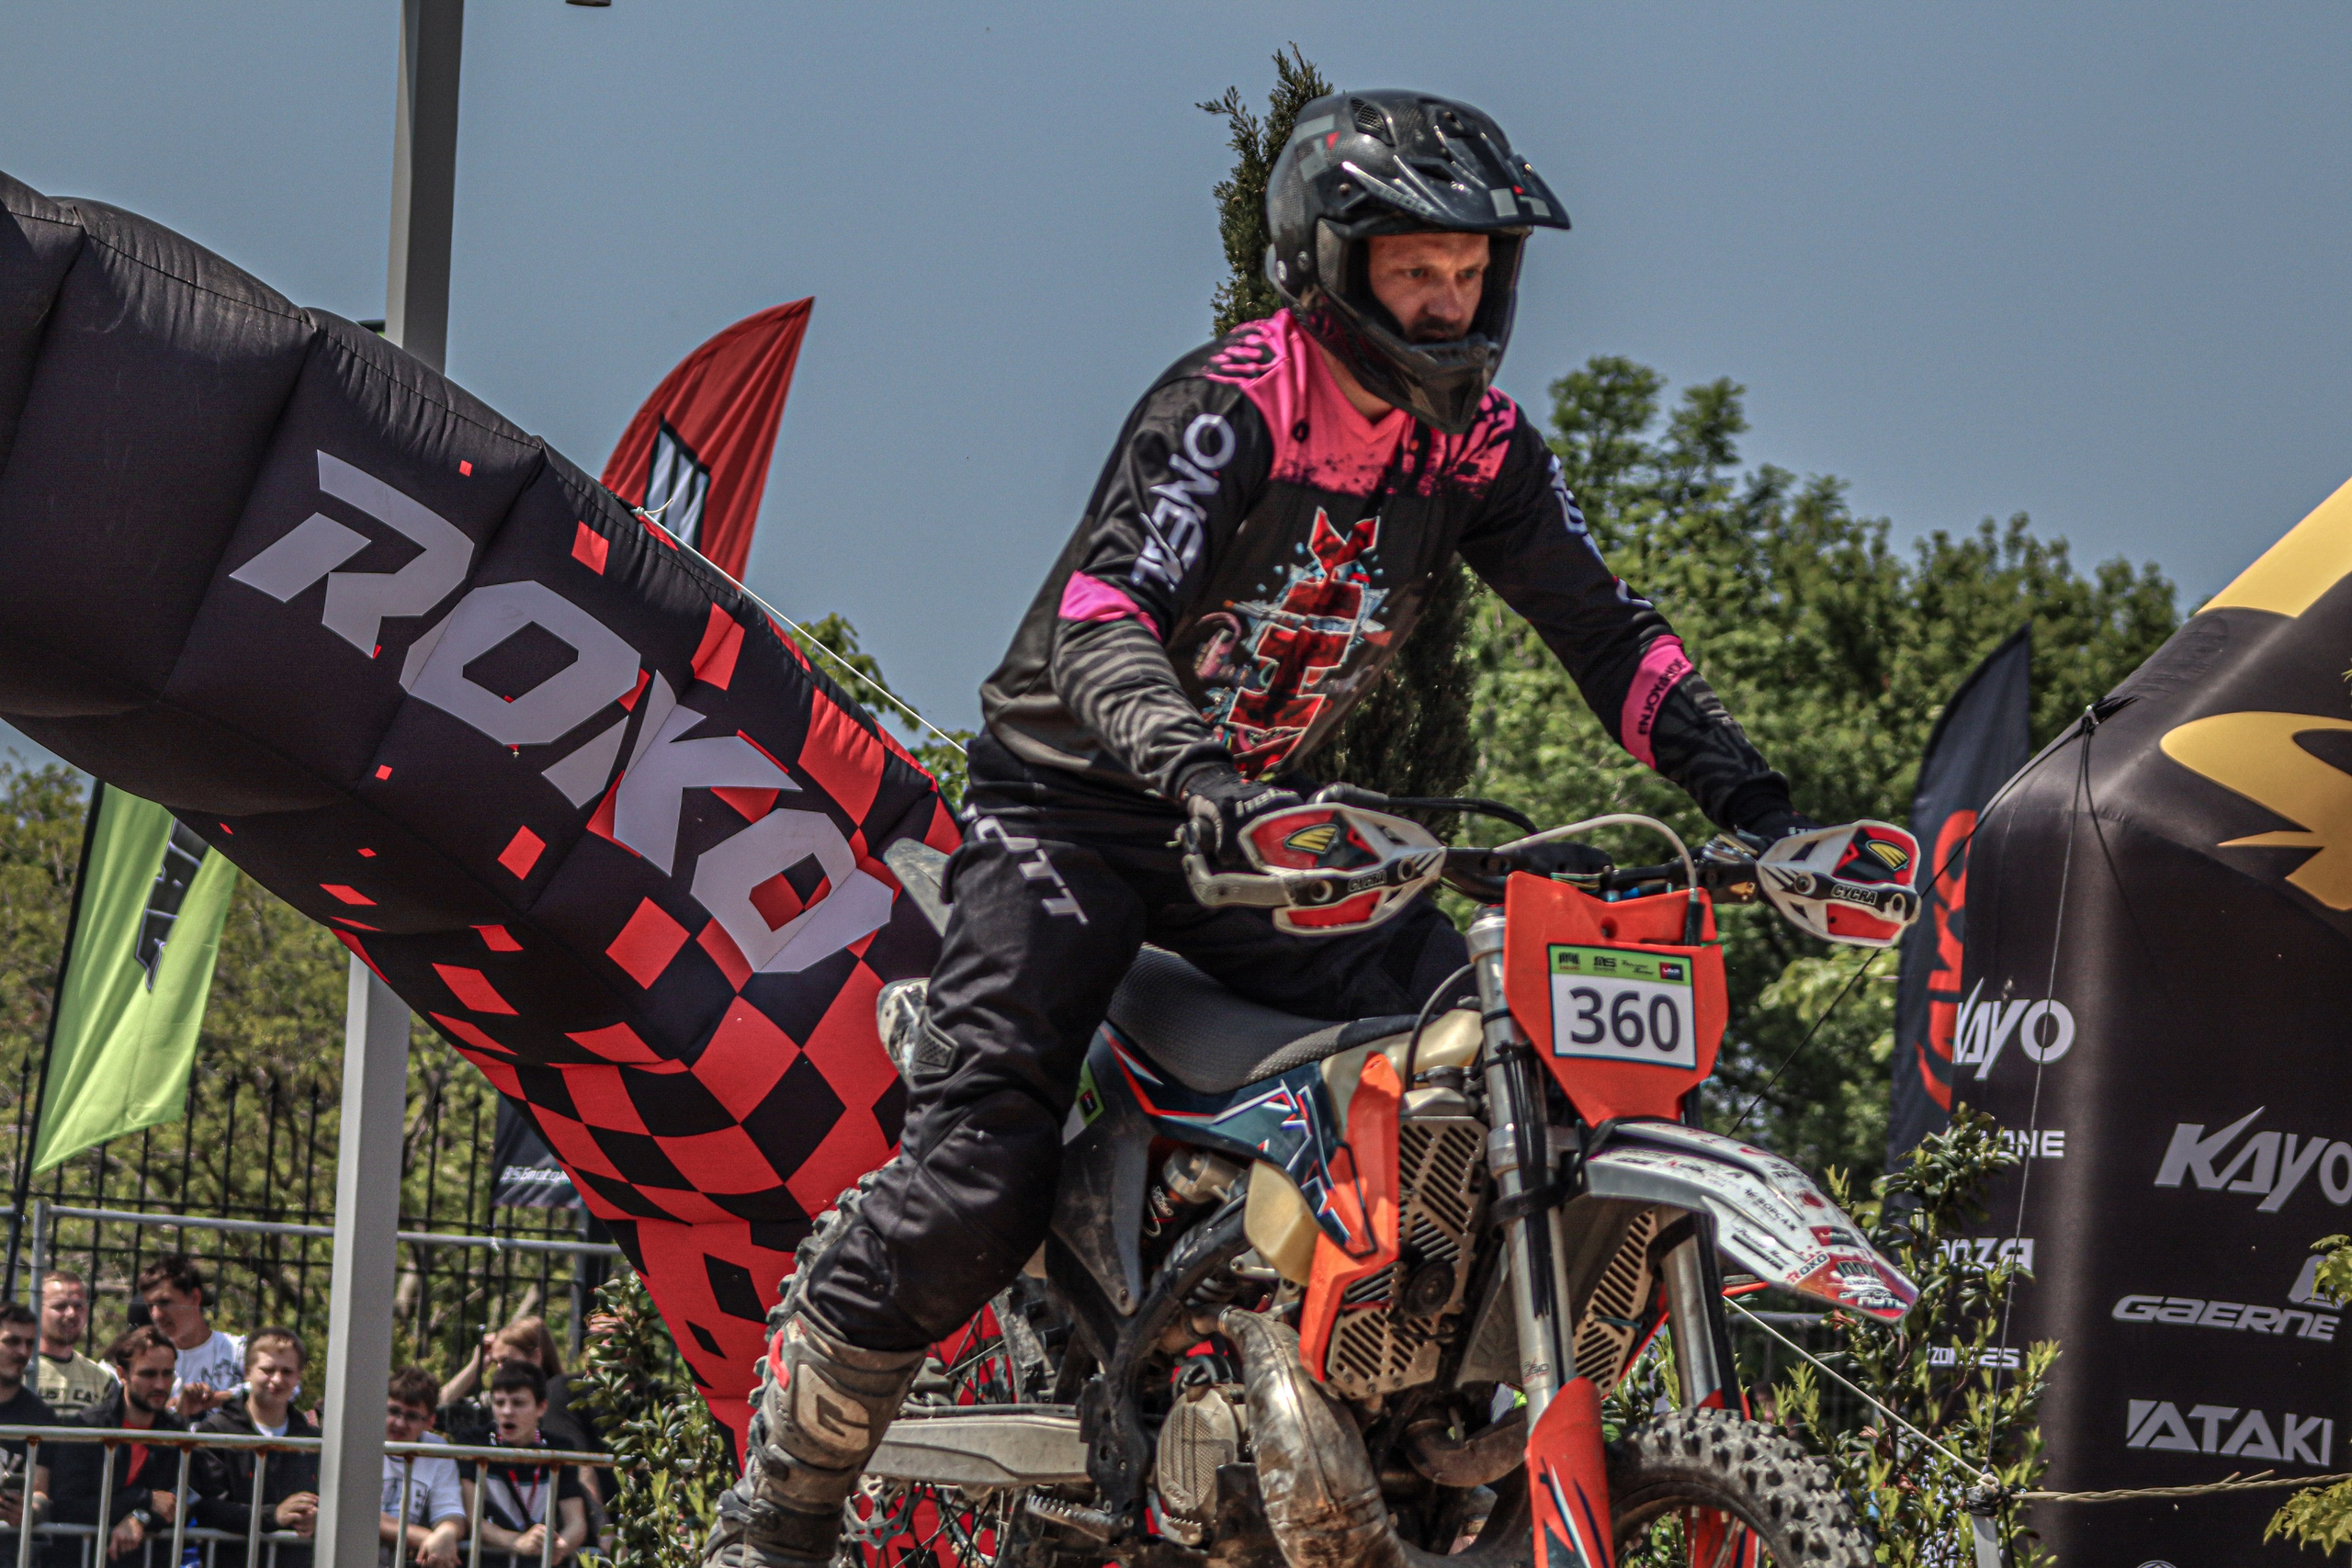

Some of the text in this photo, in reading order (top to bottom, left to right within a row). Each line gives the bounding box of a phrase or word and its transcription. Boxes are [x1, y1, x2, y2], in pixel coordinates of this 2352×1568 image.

[229, 449, 893, 974] ROKO
[1832, 885, 1877, 906] CYCRA
[1569, 986, 1680, 1053] 360
[2154, 1105, 2352, 1213] KAYO
[1785, 1253, 1827, 1283] ROKO
